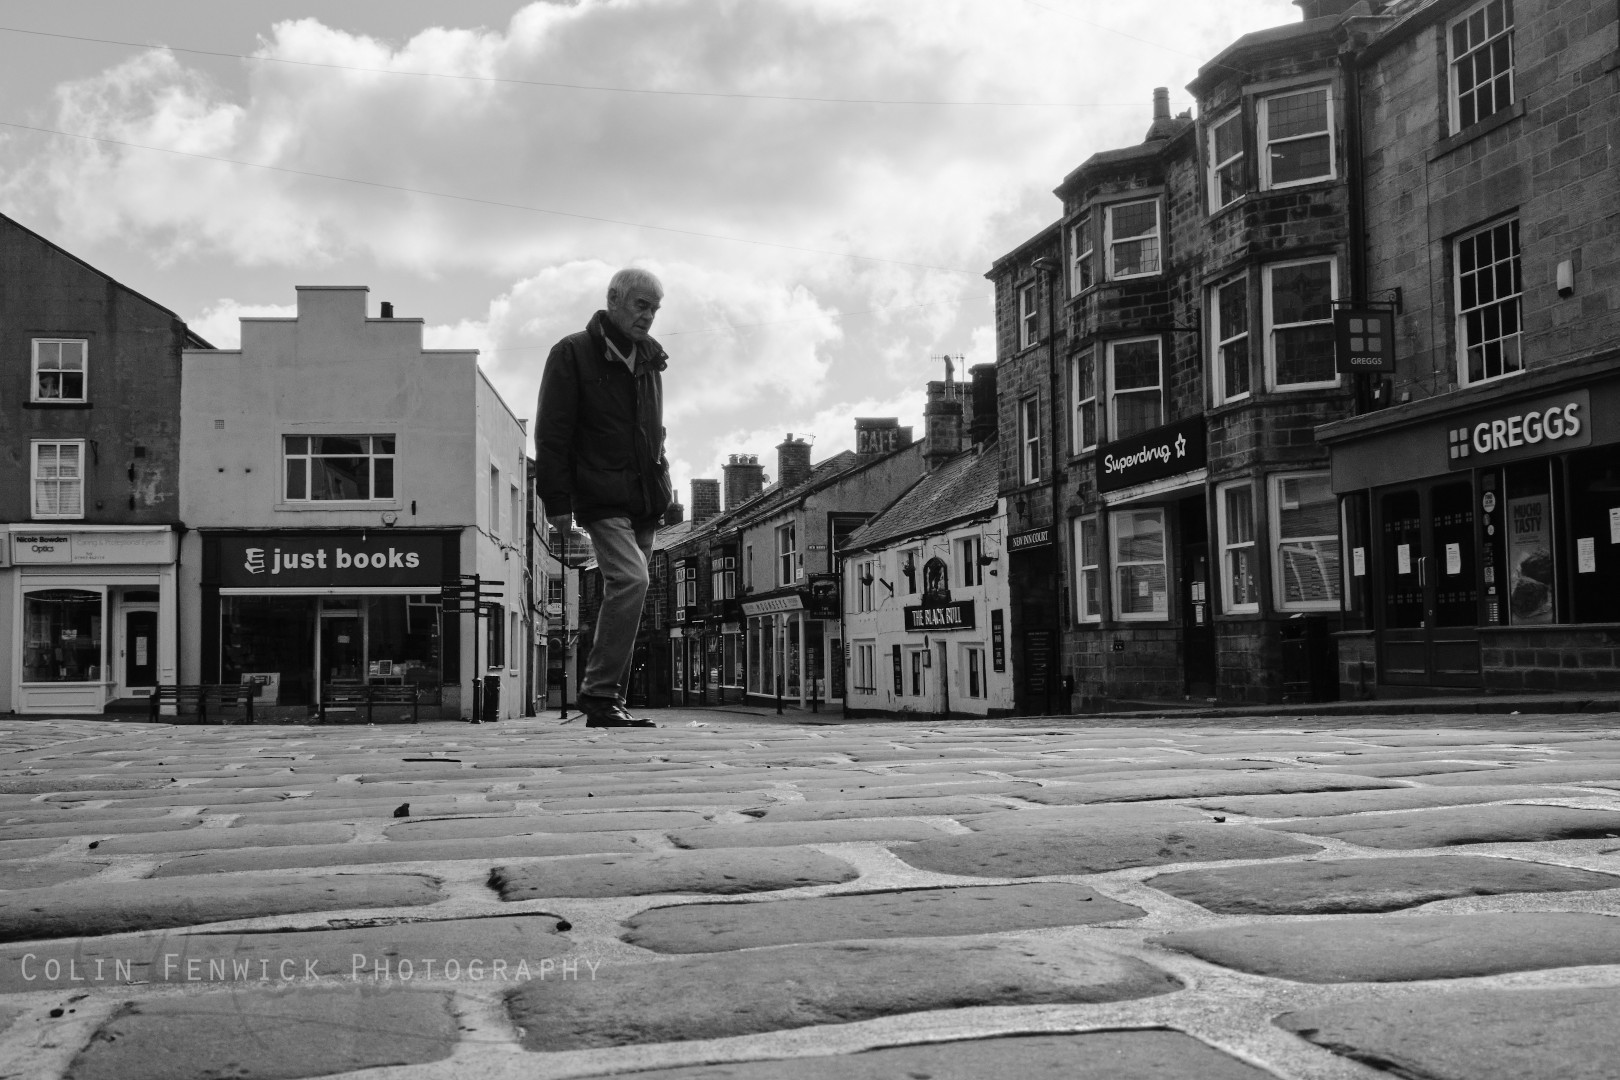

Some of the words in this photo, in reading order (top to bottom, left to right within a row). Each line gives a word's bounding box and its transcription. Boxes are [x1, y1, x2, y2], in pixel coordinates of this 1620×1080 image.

[1351, 357, 1383, 365] GREGGS
[1473, 402, 1581, 453] GREGGS
[1104, 441, 1171, 475] Superdrug
[1514, 502, 1542, 518] MUCHO
[1514, 517, 1542, 534] TASTY
[1032, 530, 1049, 543] COURT
[31, 545, 54, 553] Optics
[271, 548, 327, 575] just
[336, 547, 420, 569] books
[912, 610, 924, 627] THE
[924, 608, 945, 625] BLACK
[945, 607, 962, 624] BULL
